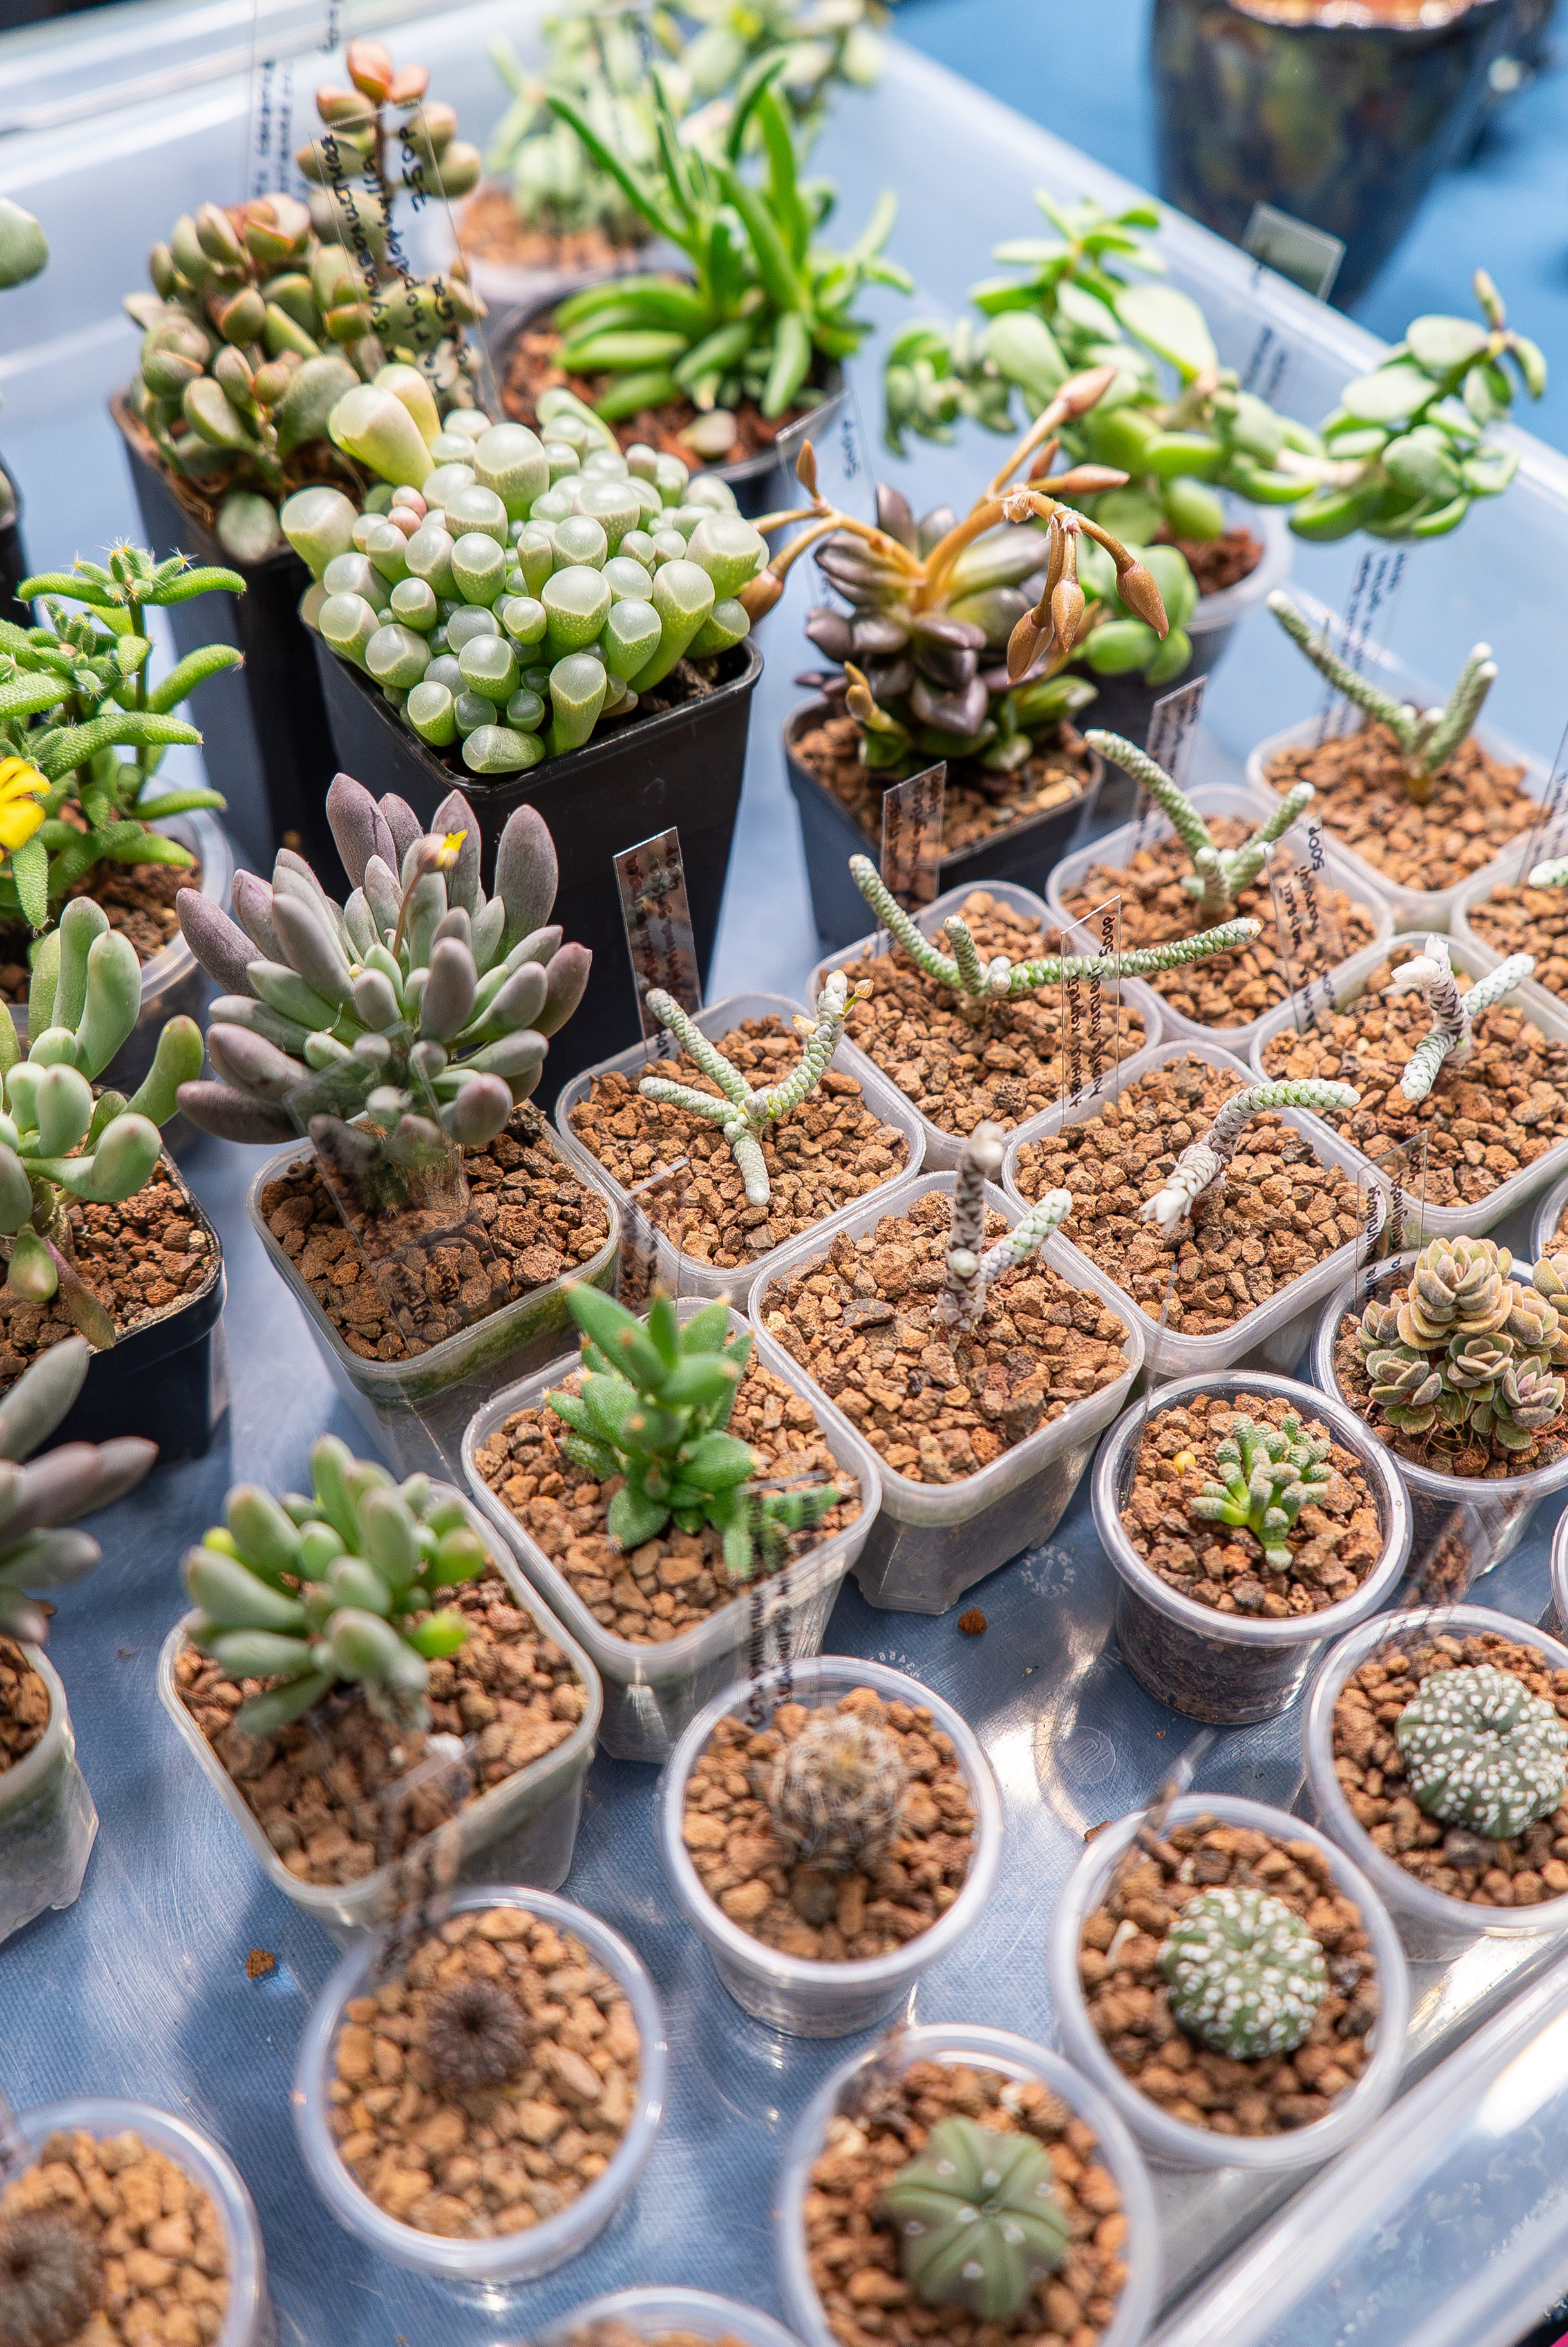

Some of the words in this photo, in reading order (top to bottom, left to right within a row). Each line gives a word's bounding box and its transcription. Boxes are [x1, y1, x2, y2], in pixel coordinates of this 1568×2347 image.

[1086, 965, 1104, 1039] harveyi
[1069, 1043, 1083, 1108] Авония
[1088, 1038, 1103, 1099] Avonia
